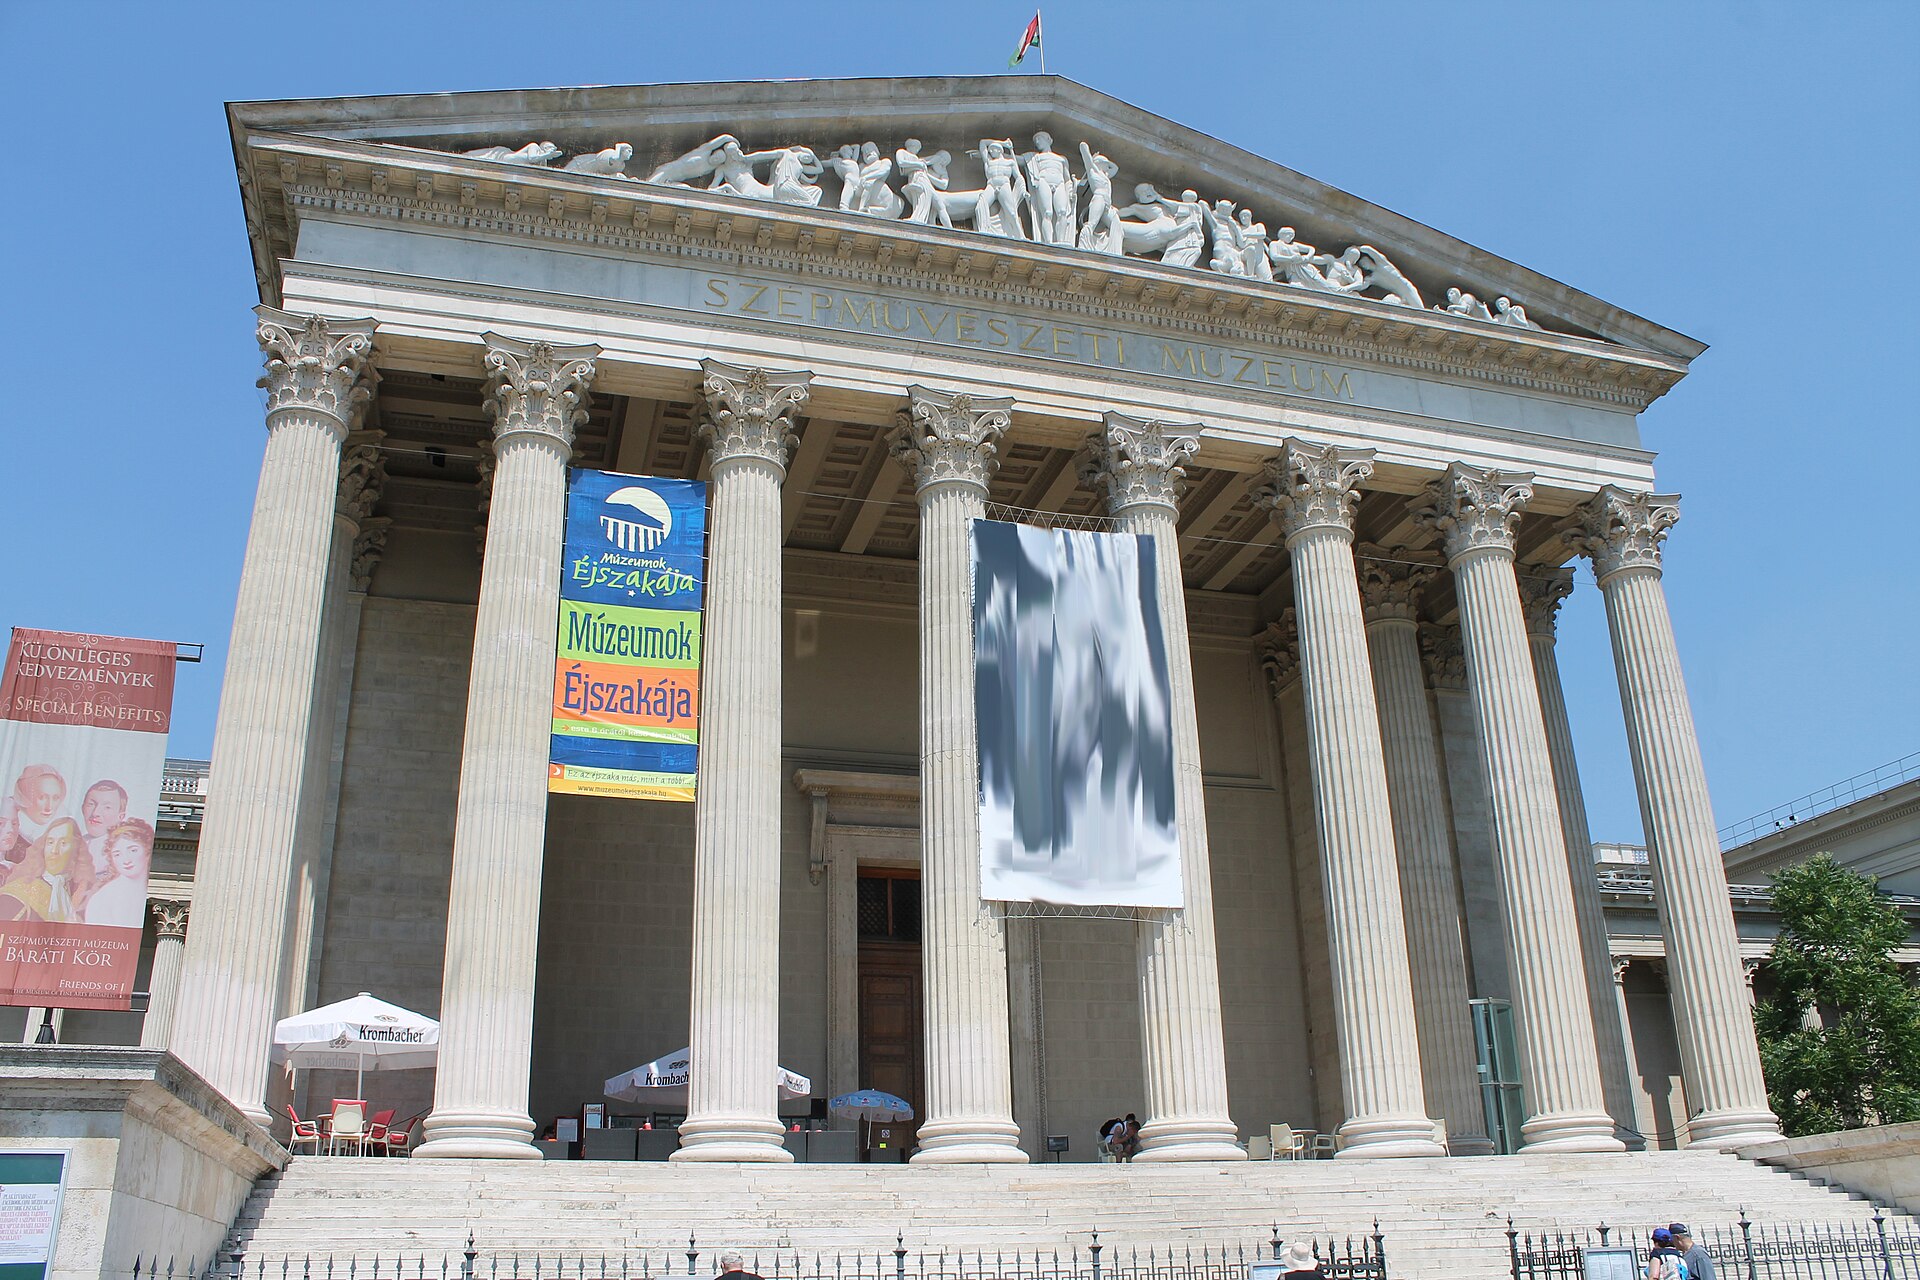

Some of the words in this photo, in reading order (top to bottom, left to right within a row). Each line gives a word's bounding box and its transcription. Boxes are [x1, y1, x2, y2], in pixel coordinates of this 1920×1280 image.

[600, 553, 667, 569] Múzeumok
[572, 555, 695, 597] Éjszakája
[567, 612, 692, 660] Múzeumok
[16, 662, 155, 688] KEDVEZMÉNYEK
[563, 663, 691, 723] Éjszakája
[15, 696, 78, 715] SPECIAL
[83, 701, 161, 723] BENEFITS
[5, 946, 65, 964] BARÁTI
[72, 949, 112, 967] KÖR
[59, 979, 102, 990] FRIENDS
[104, 982, 119, 991] OF
[359, 1024, 424, 1043] Krombacher
[645, 1073, 689, 1086] Krombach
